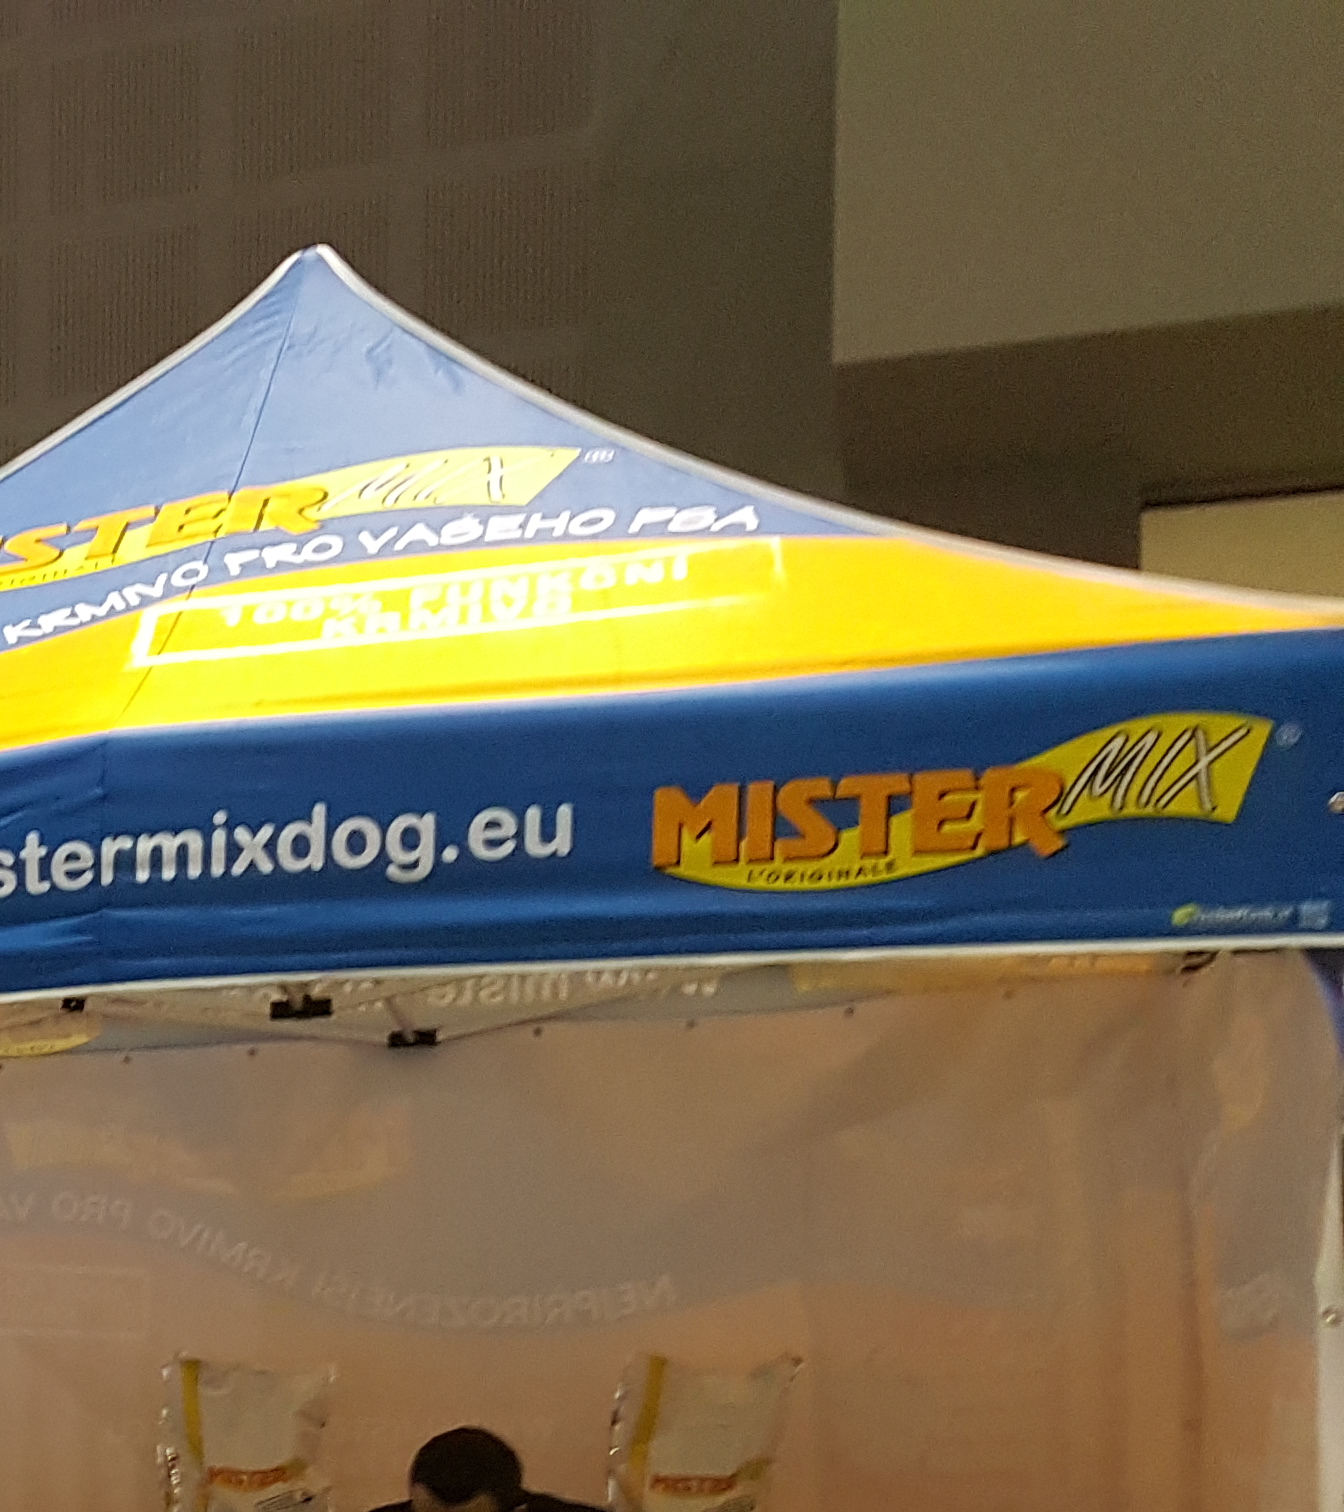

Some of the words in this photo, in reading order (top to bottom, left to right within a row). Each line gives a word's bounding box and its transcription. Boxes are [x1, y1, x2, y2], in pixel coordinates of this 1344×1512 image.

[225, 533, 342, 577] PRO
[357, 506, 616, 557] VAŠEHO
[627, 503, 761, 536] PSA
[219, 592, 383, 628] 100%
[651, 765, 1070, 869] MISTER
[1052, 722, 1251, 816] MIX
[746, 859, 900, 886] L'ORIGINALE
